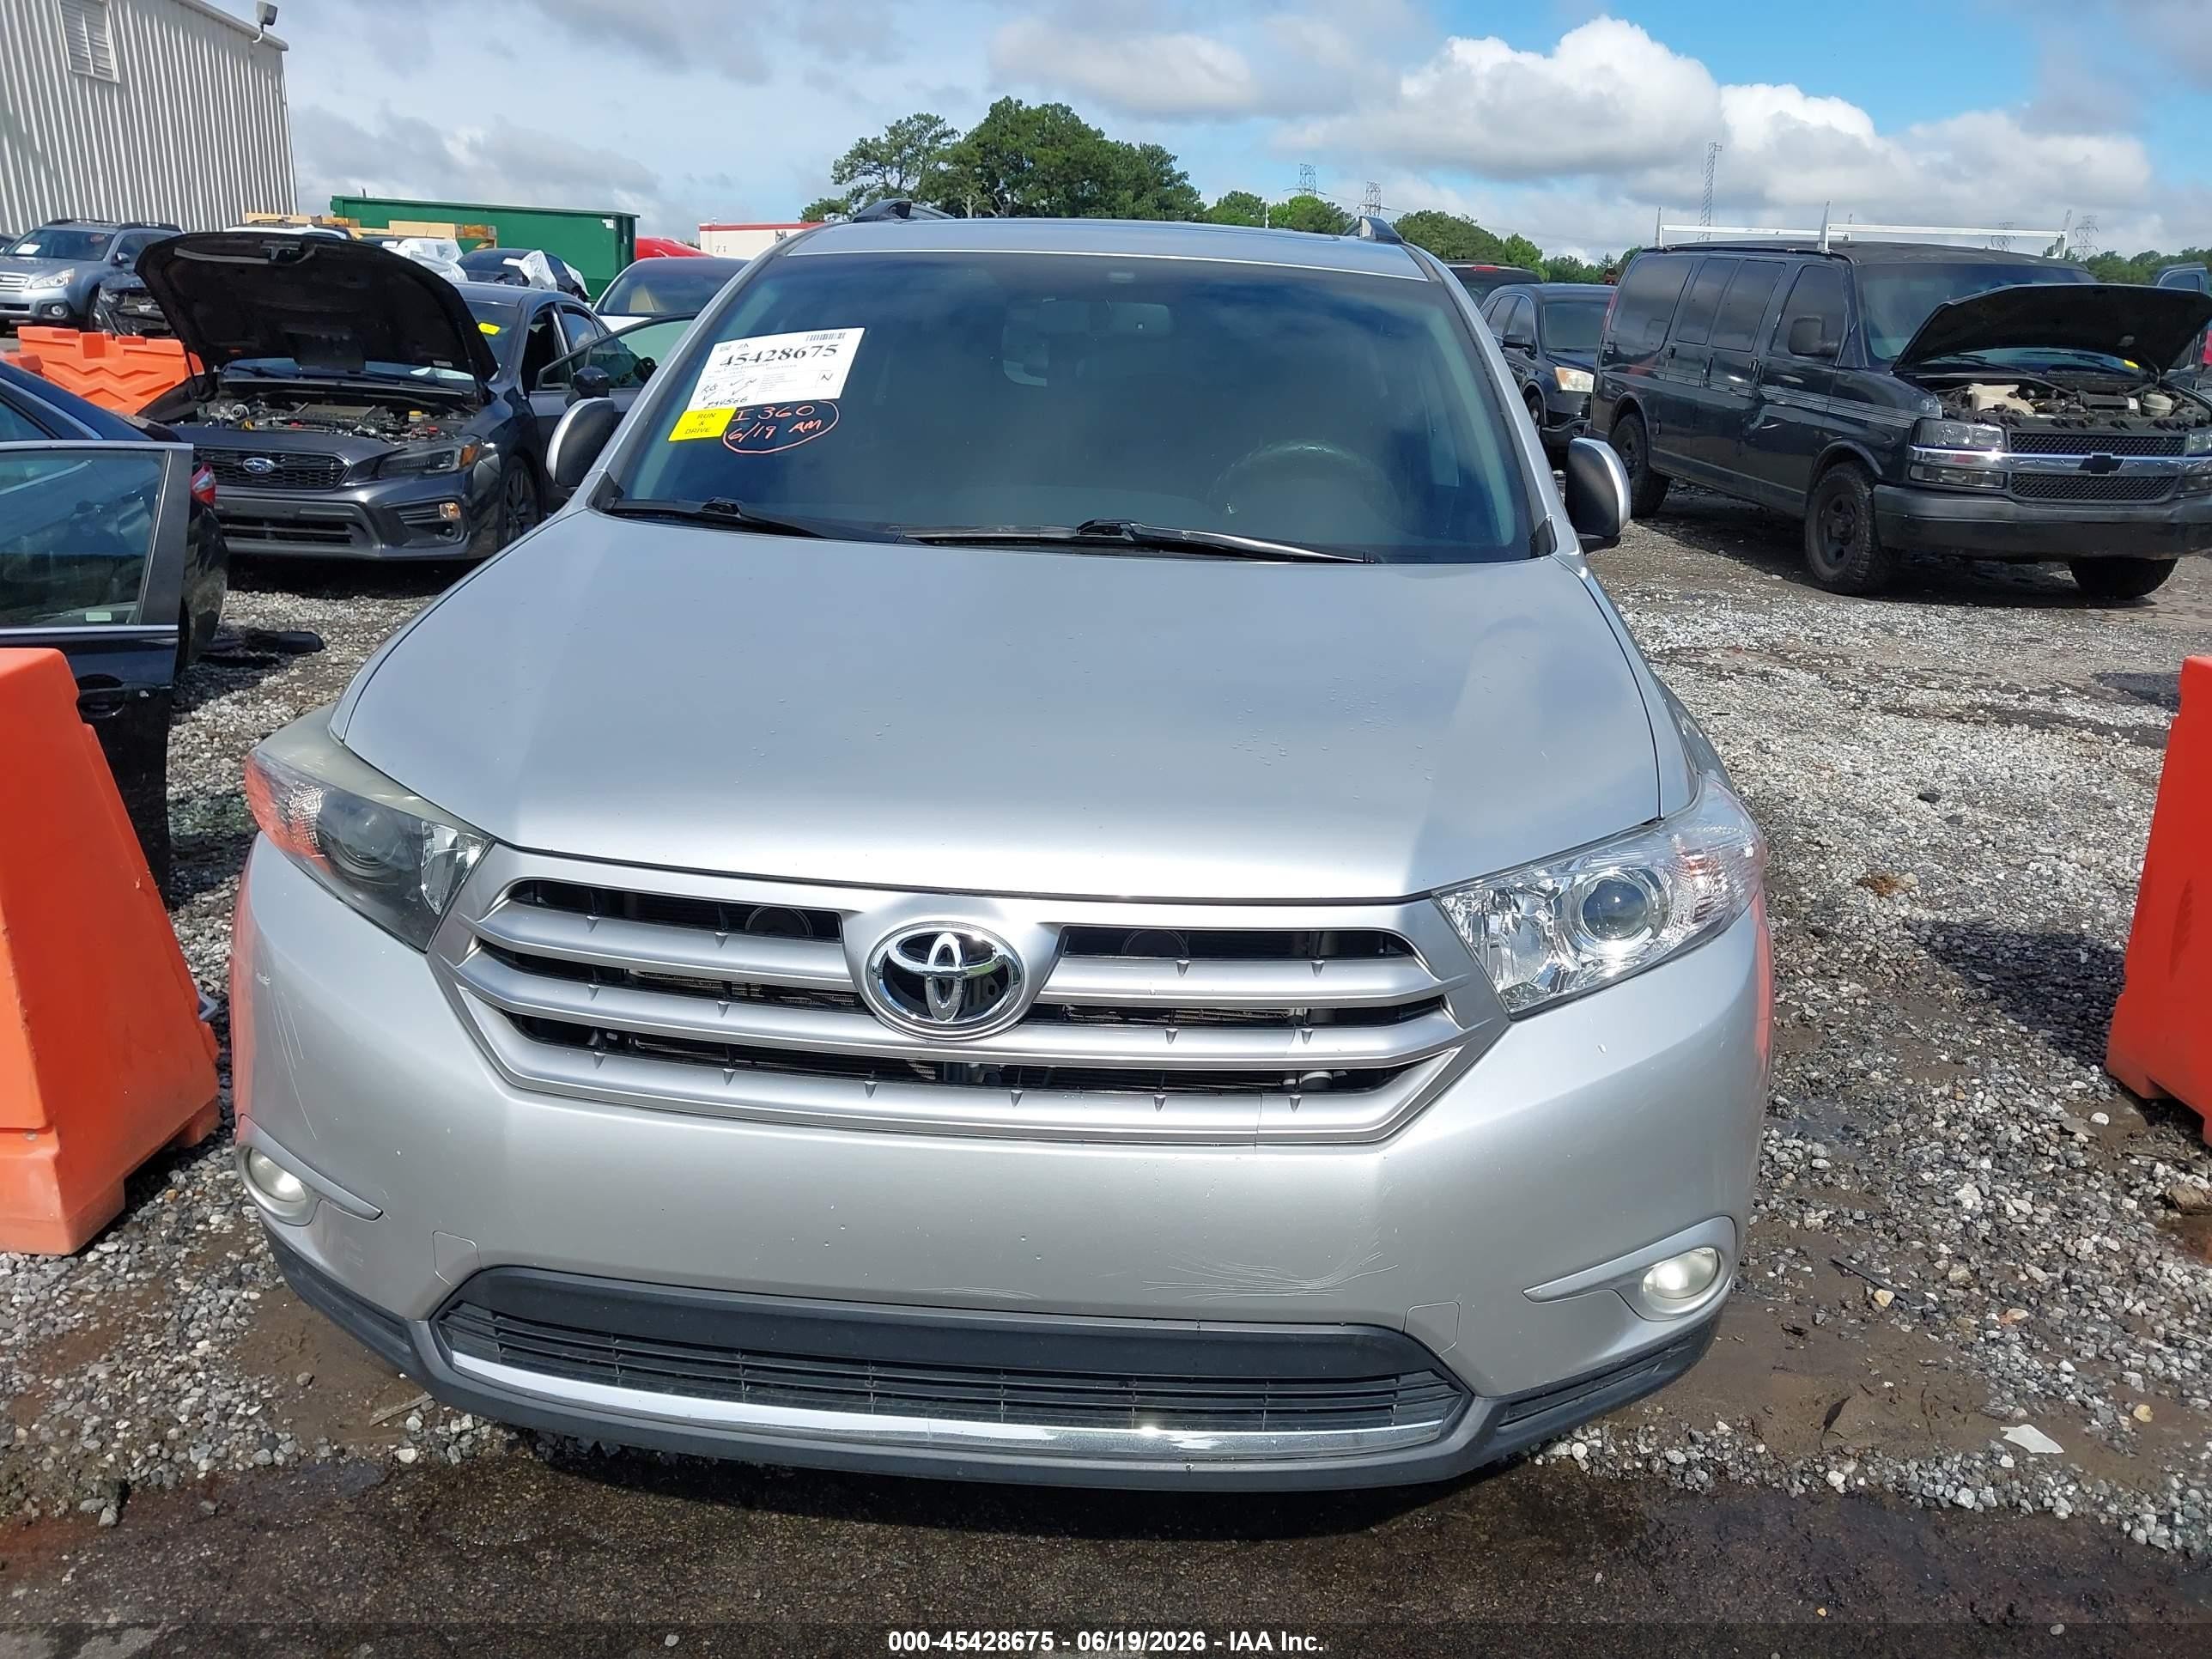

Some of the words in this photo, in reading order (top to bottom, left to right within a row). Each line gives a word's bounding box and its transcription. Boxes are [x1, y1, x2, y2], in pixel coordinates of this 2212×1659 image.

[720, 344, 839, 367] 45428675
[758, 404, 815, 420] 360
[728, 422, 777, 443] 6/19
[788, 419, 821, 433] AM
